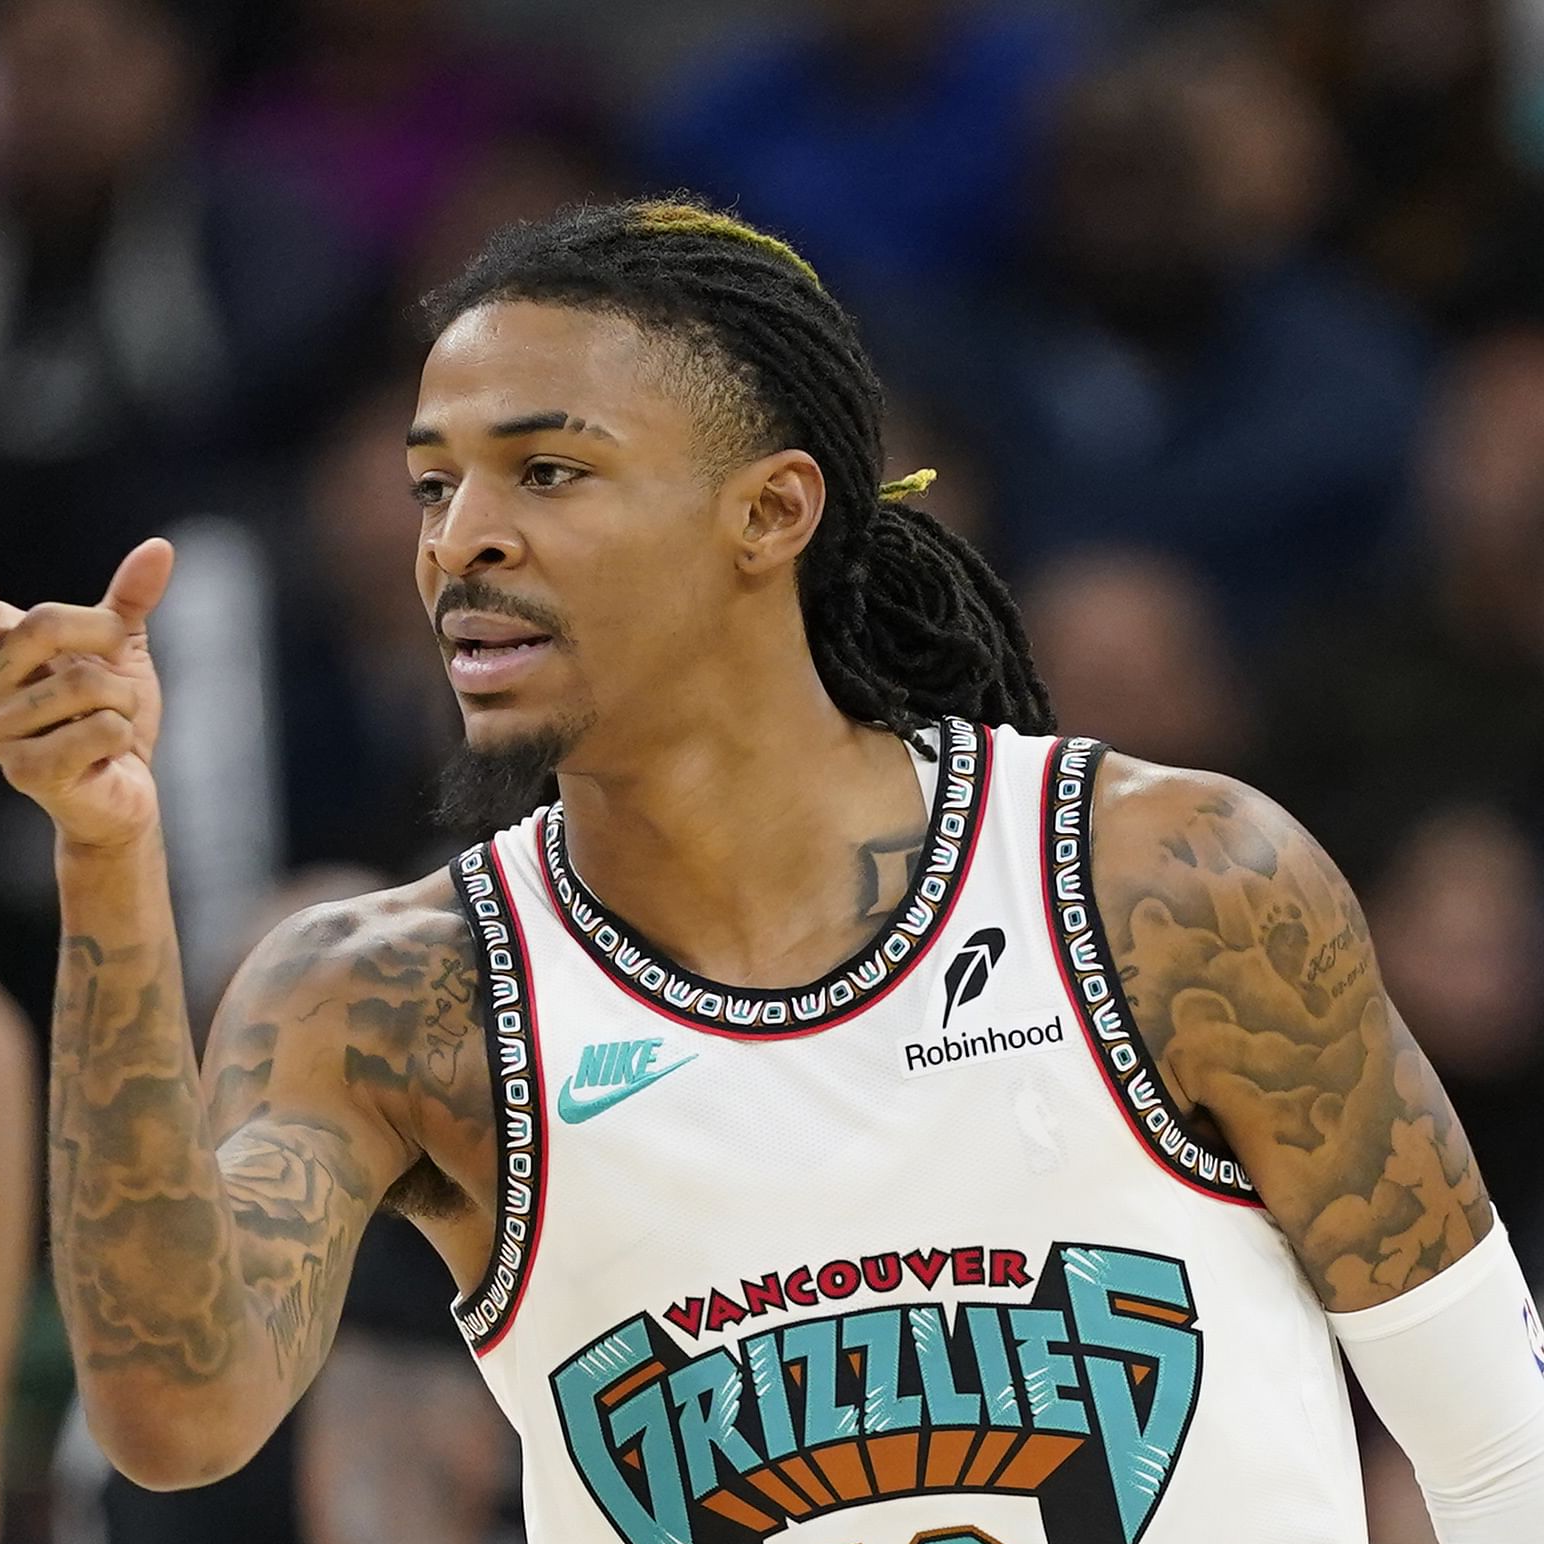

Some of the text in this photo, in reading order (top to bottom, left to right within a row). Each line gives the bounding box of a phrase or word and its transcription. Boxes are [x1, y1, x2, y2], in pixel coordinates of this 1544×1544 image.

[573, 1036, 665, 1090] NIKE
[904, 1016, 1065, 1071] Robinhood
[663, 1245, 1033, 1340] VANCOUVER
